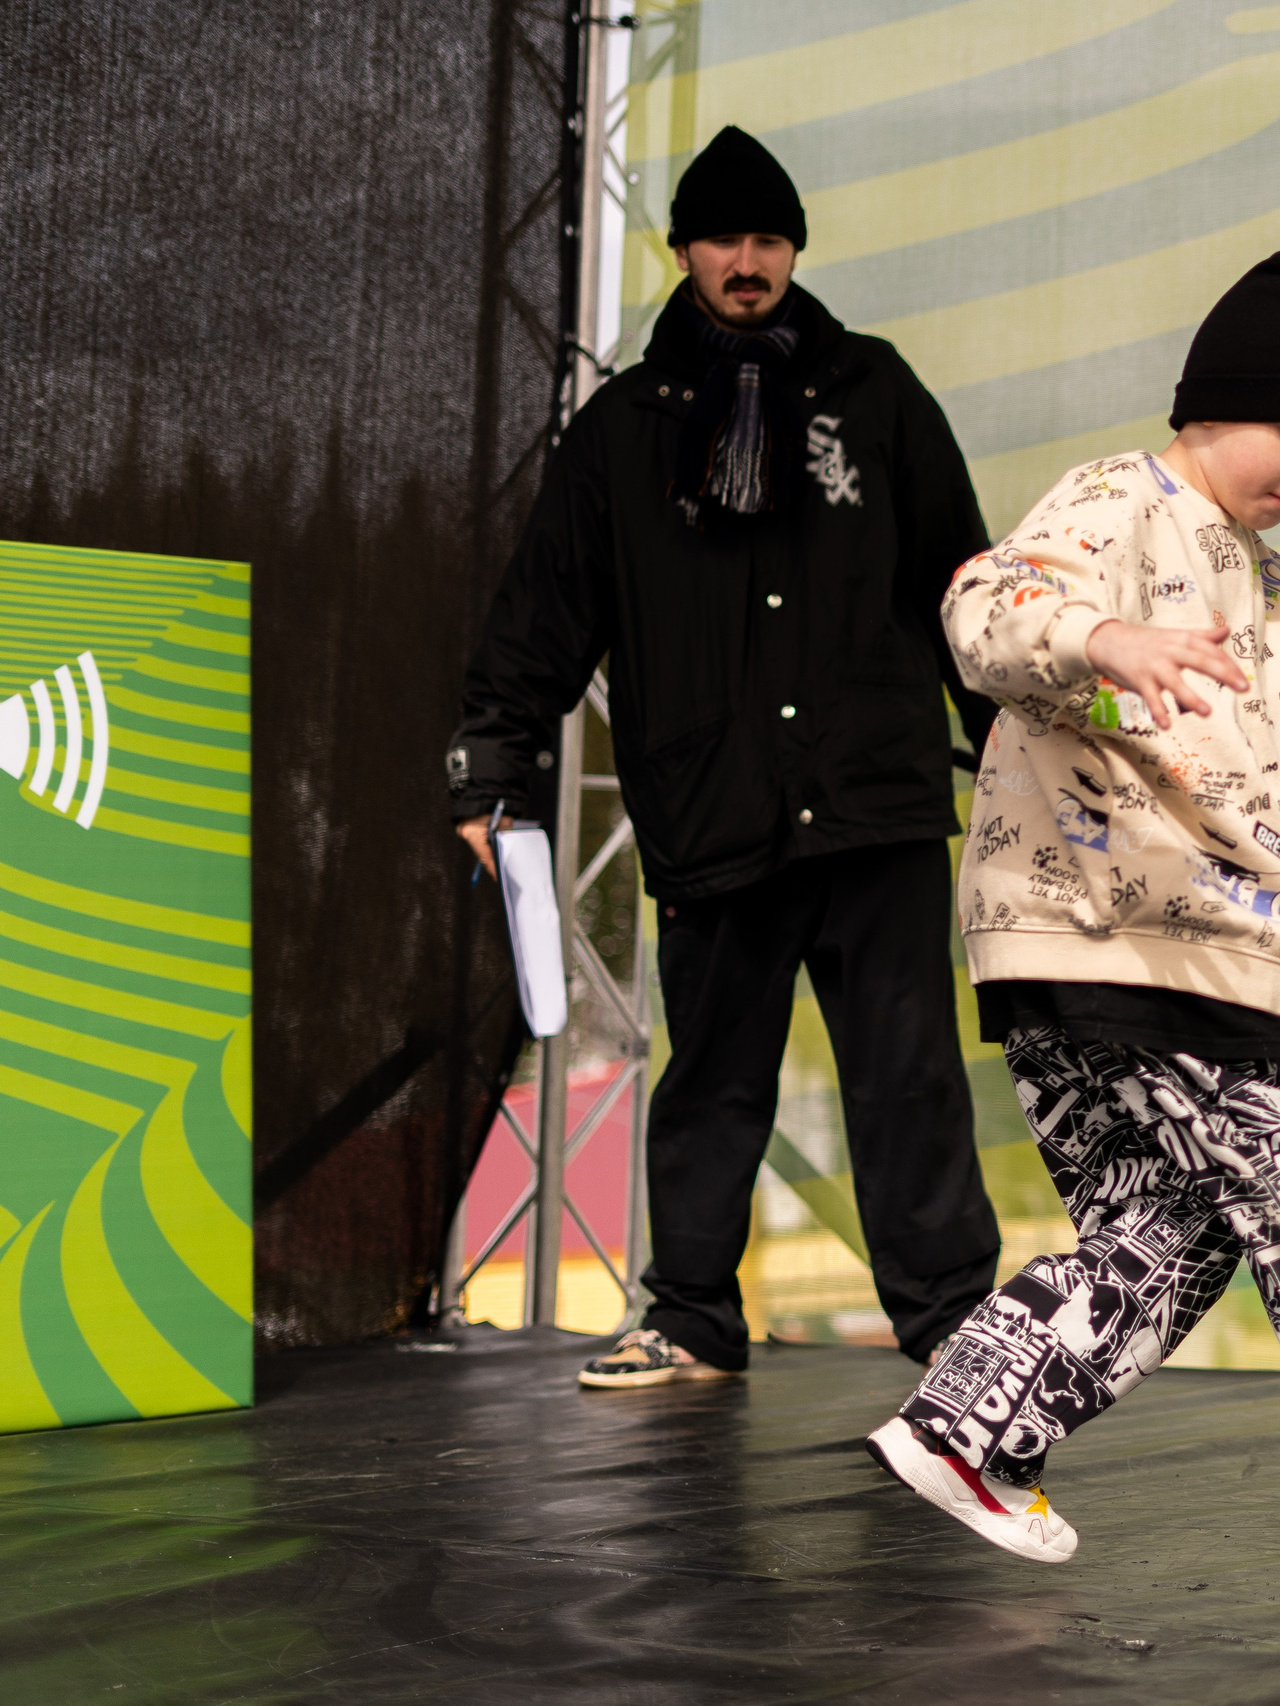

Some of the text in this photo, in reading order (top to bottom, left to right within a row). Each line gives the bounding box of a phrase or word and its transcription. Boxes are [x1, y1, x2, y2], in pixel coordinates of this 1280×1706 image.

[1151, 581, 1184, 599] HEY!
[983, 815, 1005, 841] NOT
[977, 823, 1021, 863] TODAY
[1029, 873, 1089, 899] PROBABLY
[1045, 867, 1080, 884] SOON
[1028, 884, 1078, 904] NOT YET
